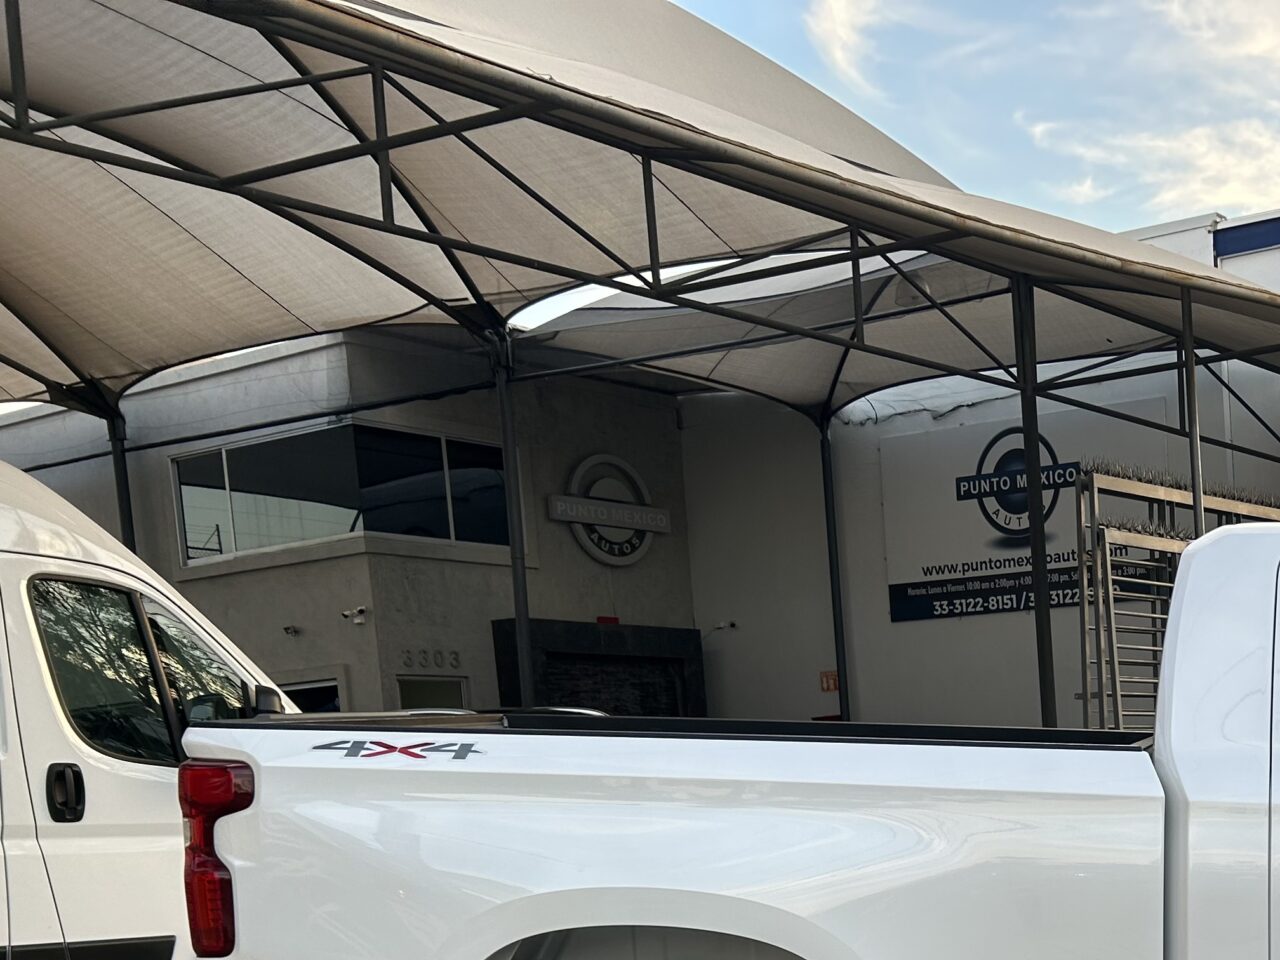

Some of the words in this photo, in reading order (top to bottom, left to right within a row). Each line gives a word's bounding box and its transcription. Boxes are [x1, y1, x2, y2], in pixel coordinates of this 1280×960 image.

[960, 476, 1011, 496] PUNTO
[1016, 467, 1077, 489] MXICO
[557, 501, 609, 520] PUNTO
[611, 508, 667, 527] MEXICO
[991, 507, 1046, 527] AUT
[590, 531, 641, 555] AUTOS
[932, 594, 1017, 616] 33-3122-8151
[402, 649, 463, 671] 3303
